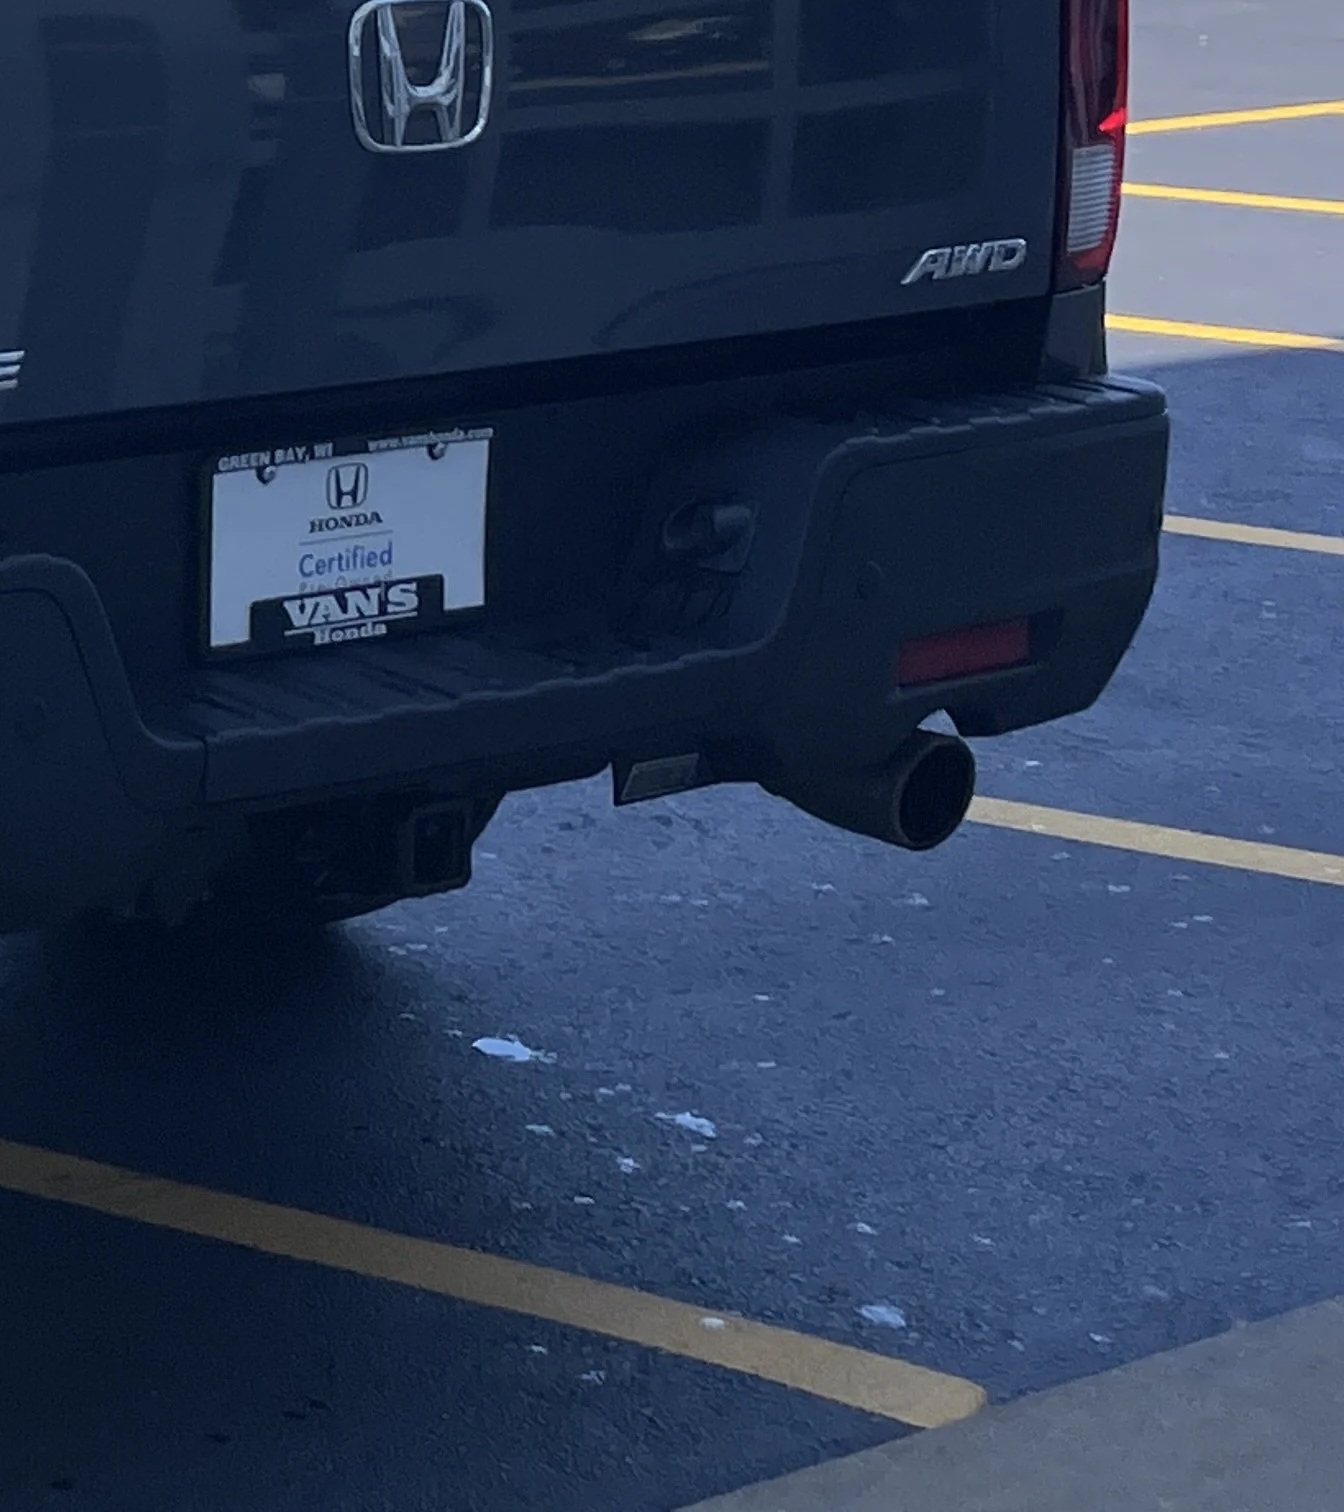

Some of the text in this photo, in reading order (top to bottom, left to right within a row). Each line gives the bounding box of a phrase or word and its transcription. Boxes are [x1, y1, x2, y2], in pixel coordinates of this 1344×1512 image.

[900, 238, 1027, 285] AWD
[218, 450, 271, 472] GREEN
[308, 511, 384, 534] HONDA
[298, 540, 393, 578] Certified
[313, 621, 388, 646] Honda
